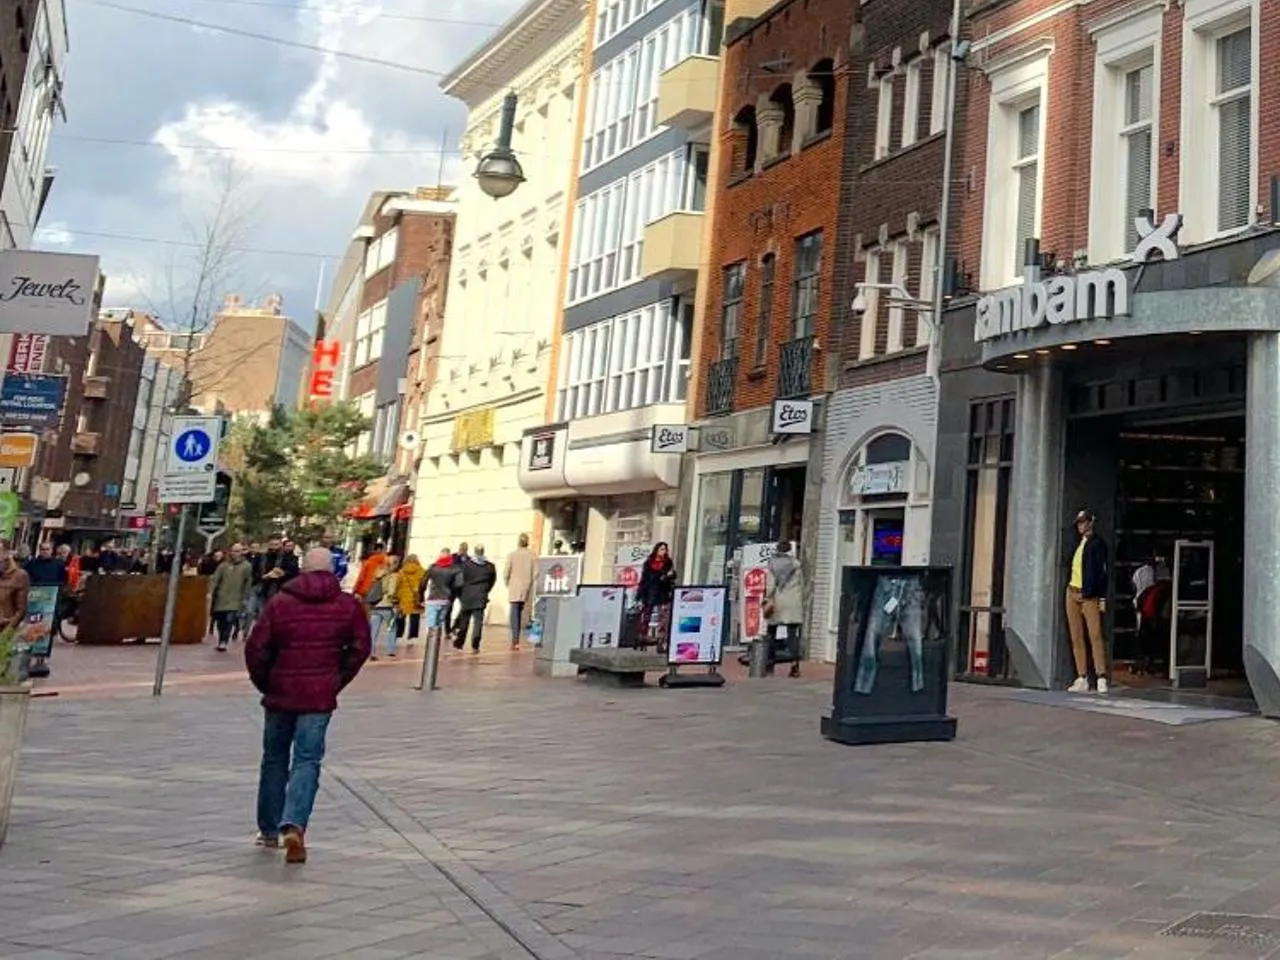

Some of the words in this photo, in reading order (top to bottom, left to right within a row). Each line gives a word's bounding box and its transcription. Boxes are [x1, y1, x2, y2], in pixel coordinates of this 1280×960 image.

[0, 276, 85, 305] Jewelz
[780, 404, 808, 424] Etos
[658, 428, 684, 446] Etos
[544, 574, 568, 592] hit
